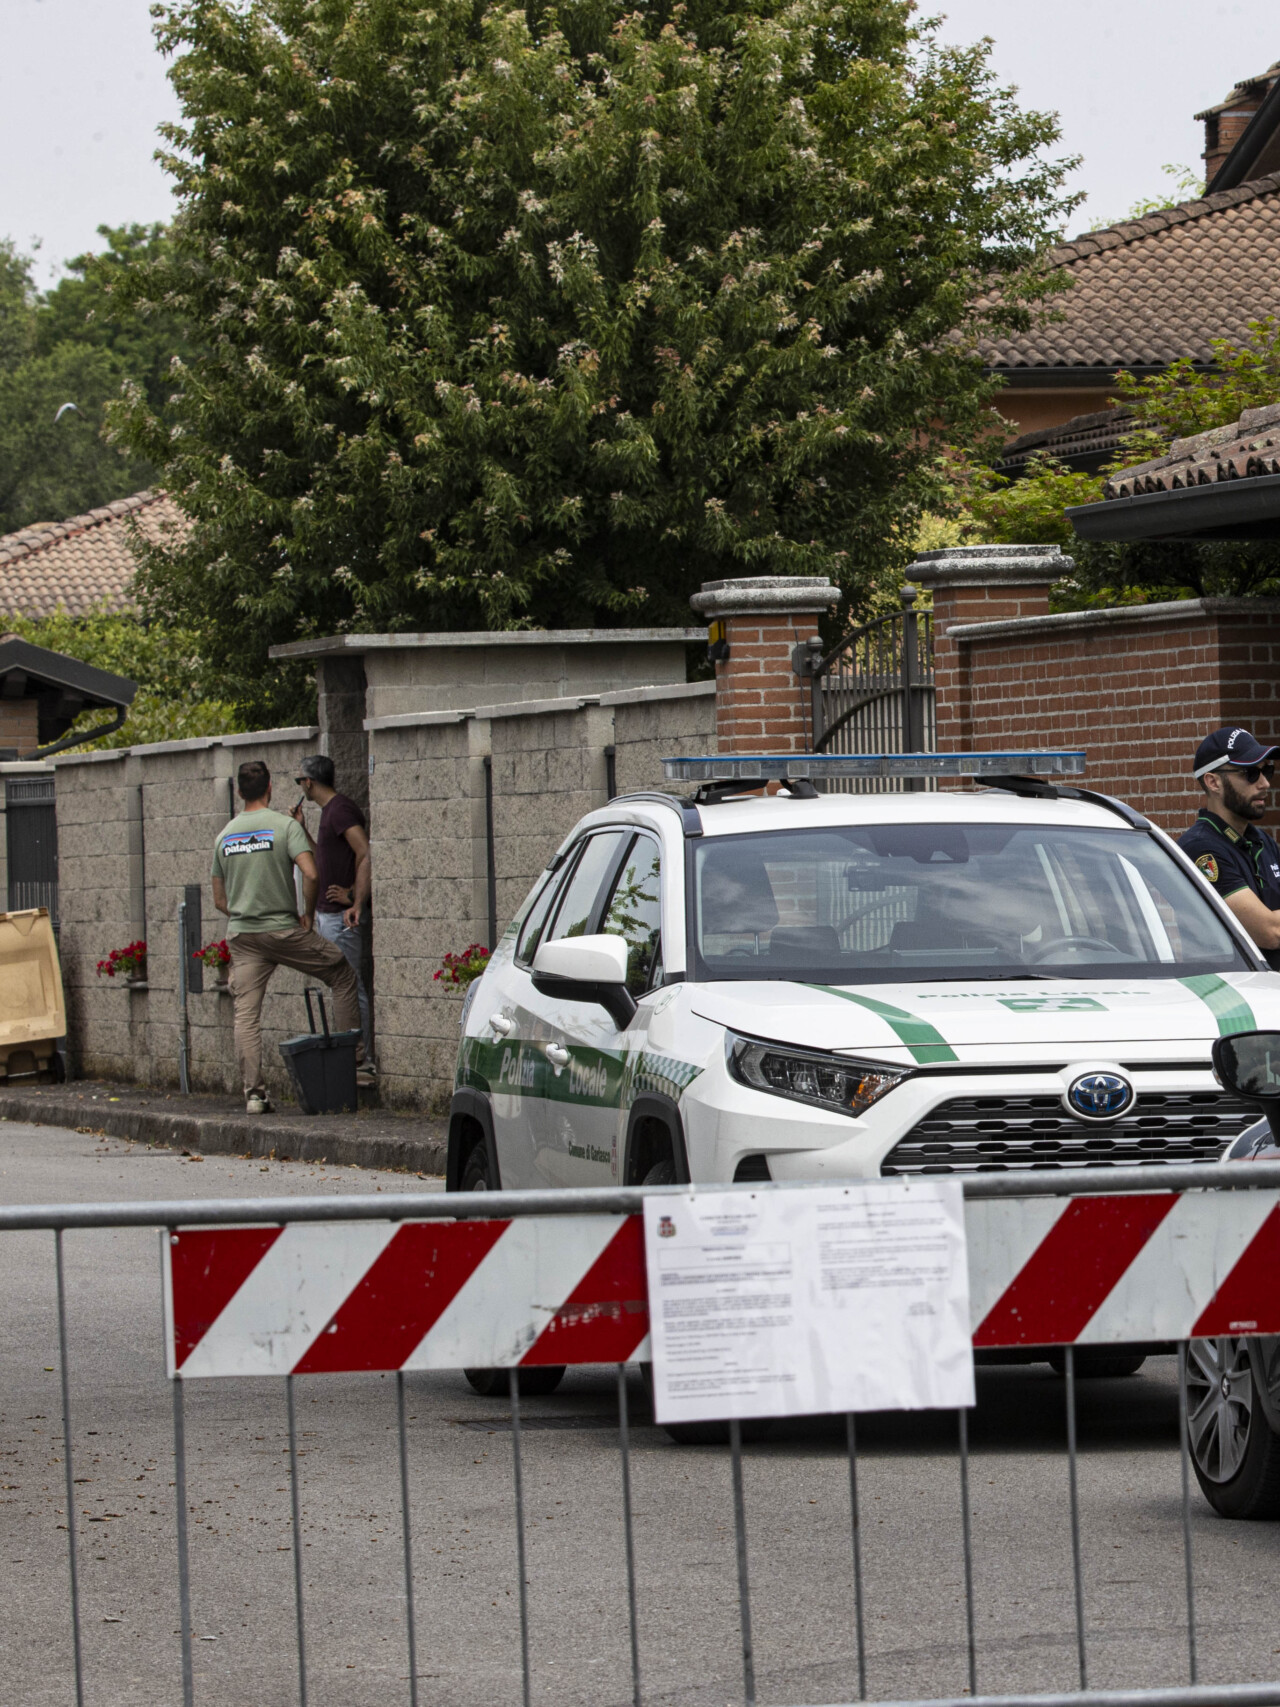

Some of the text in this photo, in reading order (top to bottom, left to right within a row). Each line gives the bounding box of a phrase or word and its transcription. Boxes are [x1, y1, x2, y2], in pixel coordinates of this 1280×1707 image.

[224, 841, 270, 856] patagonia
[499, 1046, 607, 1098] Polizia Locale
